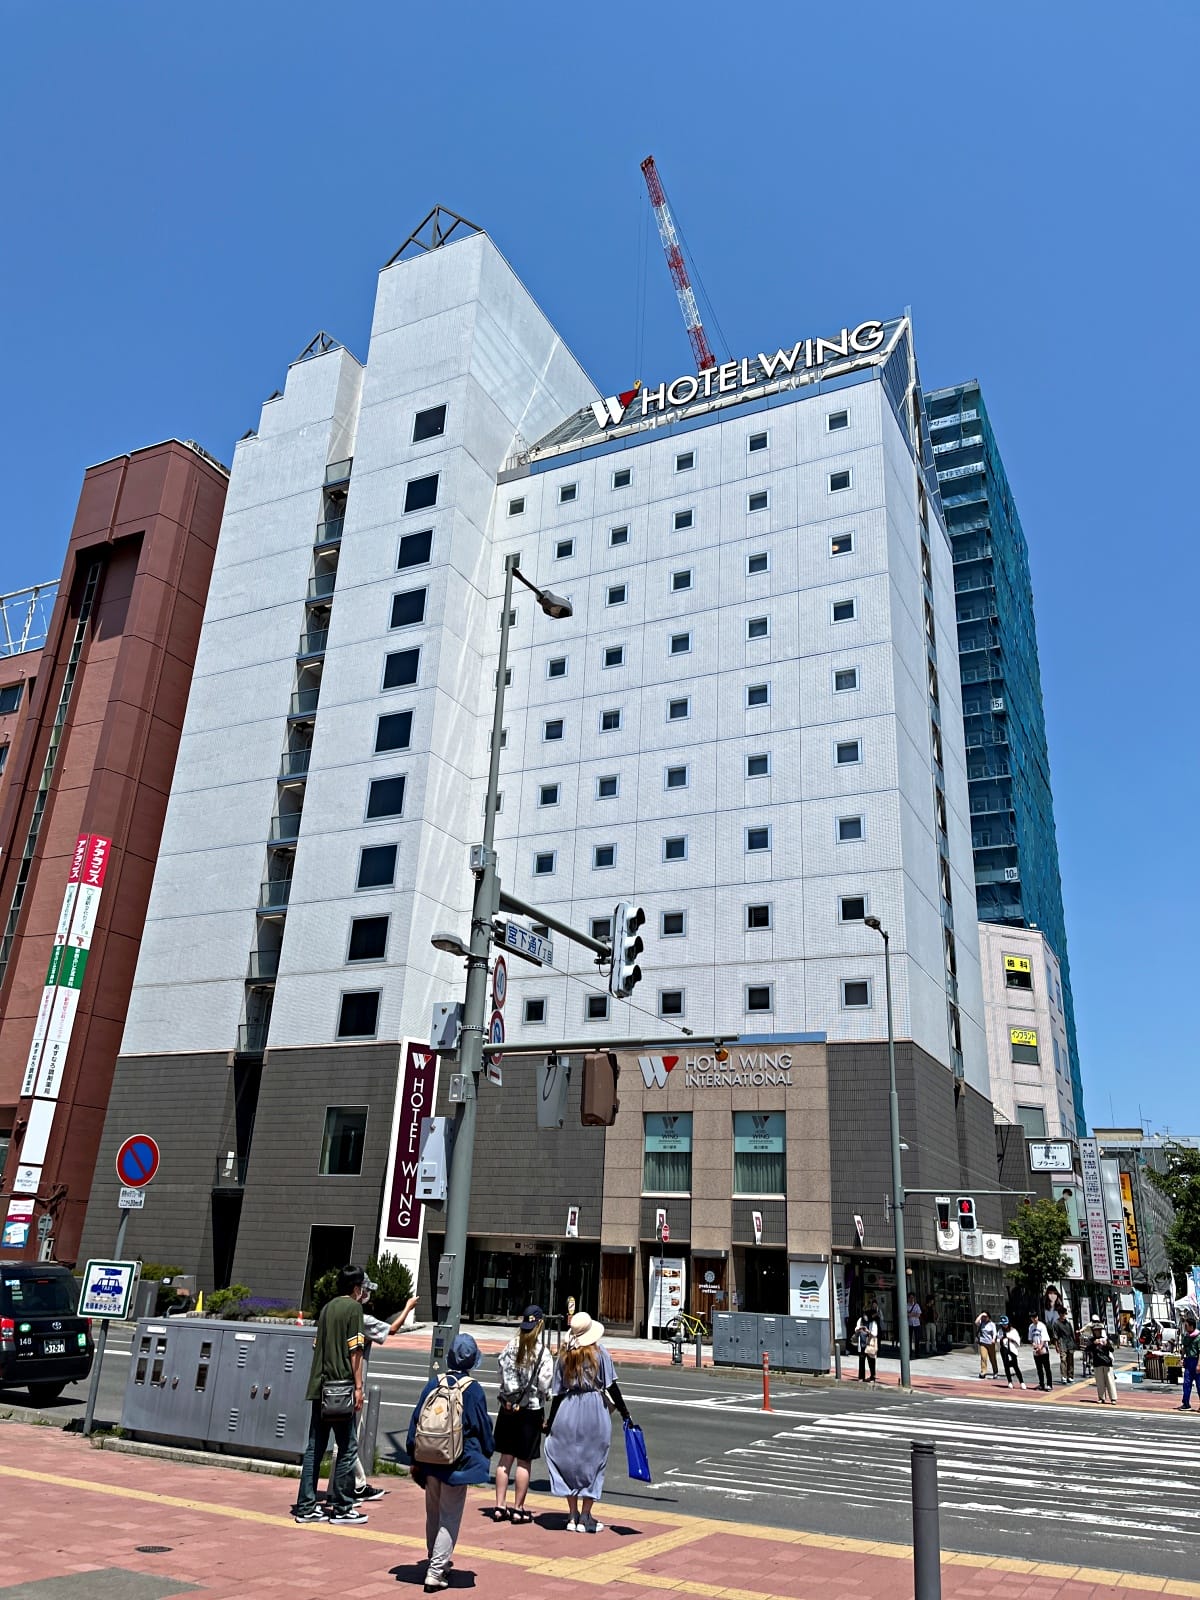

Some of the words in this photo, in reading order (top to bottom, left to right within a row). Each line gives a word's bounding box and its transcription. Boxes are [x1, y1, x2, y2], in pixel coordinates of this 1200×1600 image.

[641, 357, 757, 417] HOTEL
[757, 319, 885, 379] WING
[70, 839, 87, 879] アデランス
[86, 838, 107, 884] アデランス
[507, 924, 553, 966] 宮下通7丁目
[496, 969, 505, 996] 40
[1011, 1030, 1036, 1041] インプラント
[685, 1071, 793, 1089] INTERNATIONAL
[738, 1052, 793, 1071] WING
[408, 1077, 424, 1153] HOTEL
[397, 1160, 419, 1227] WING
